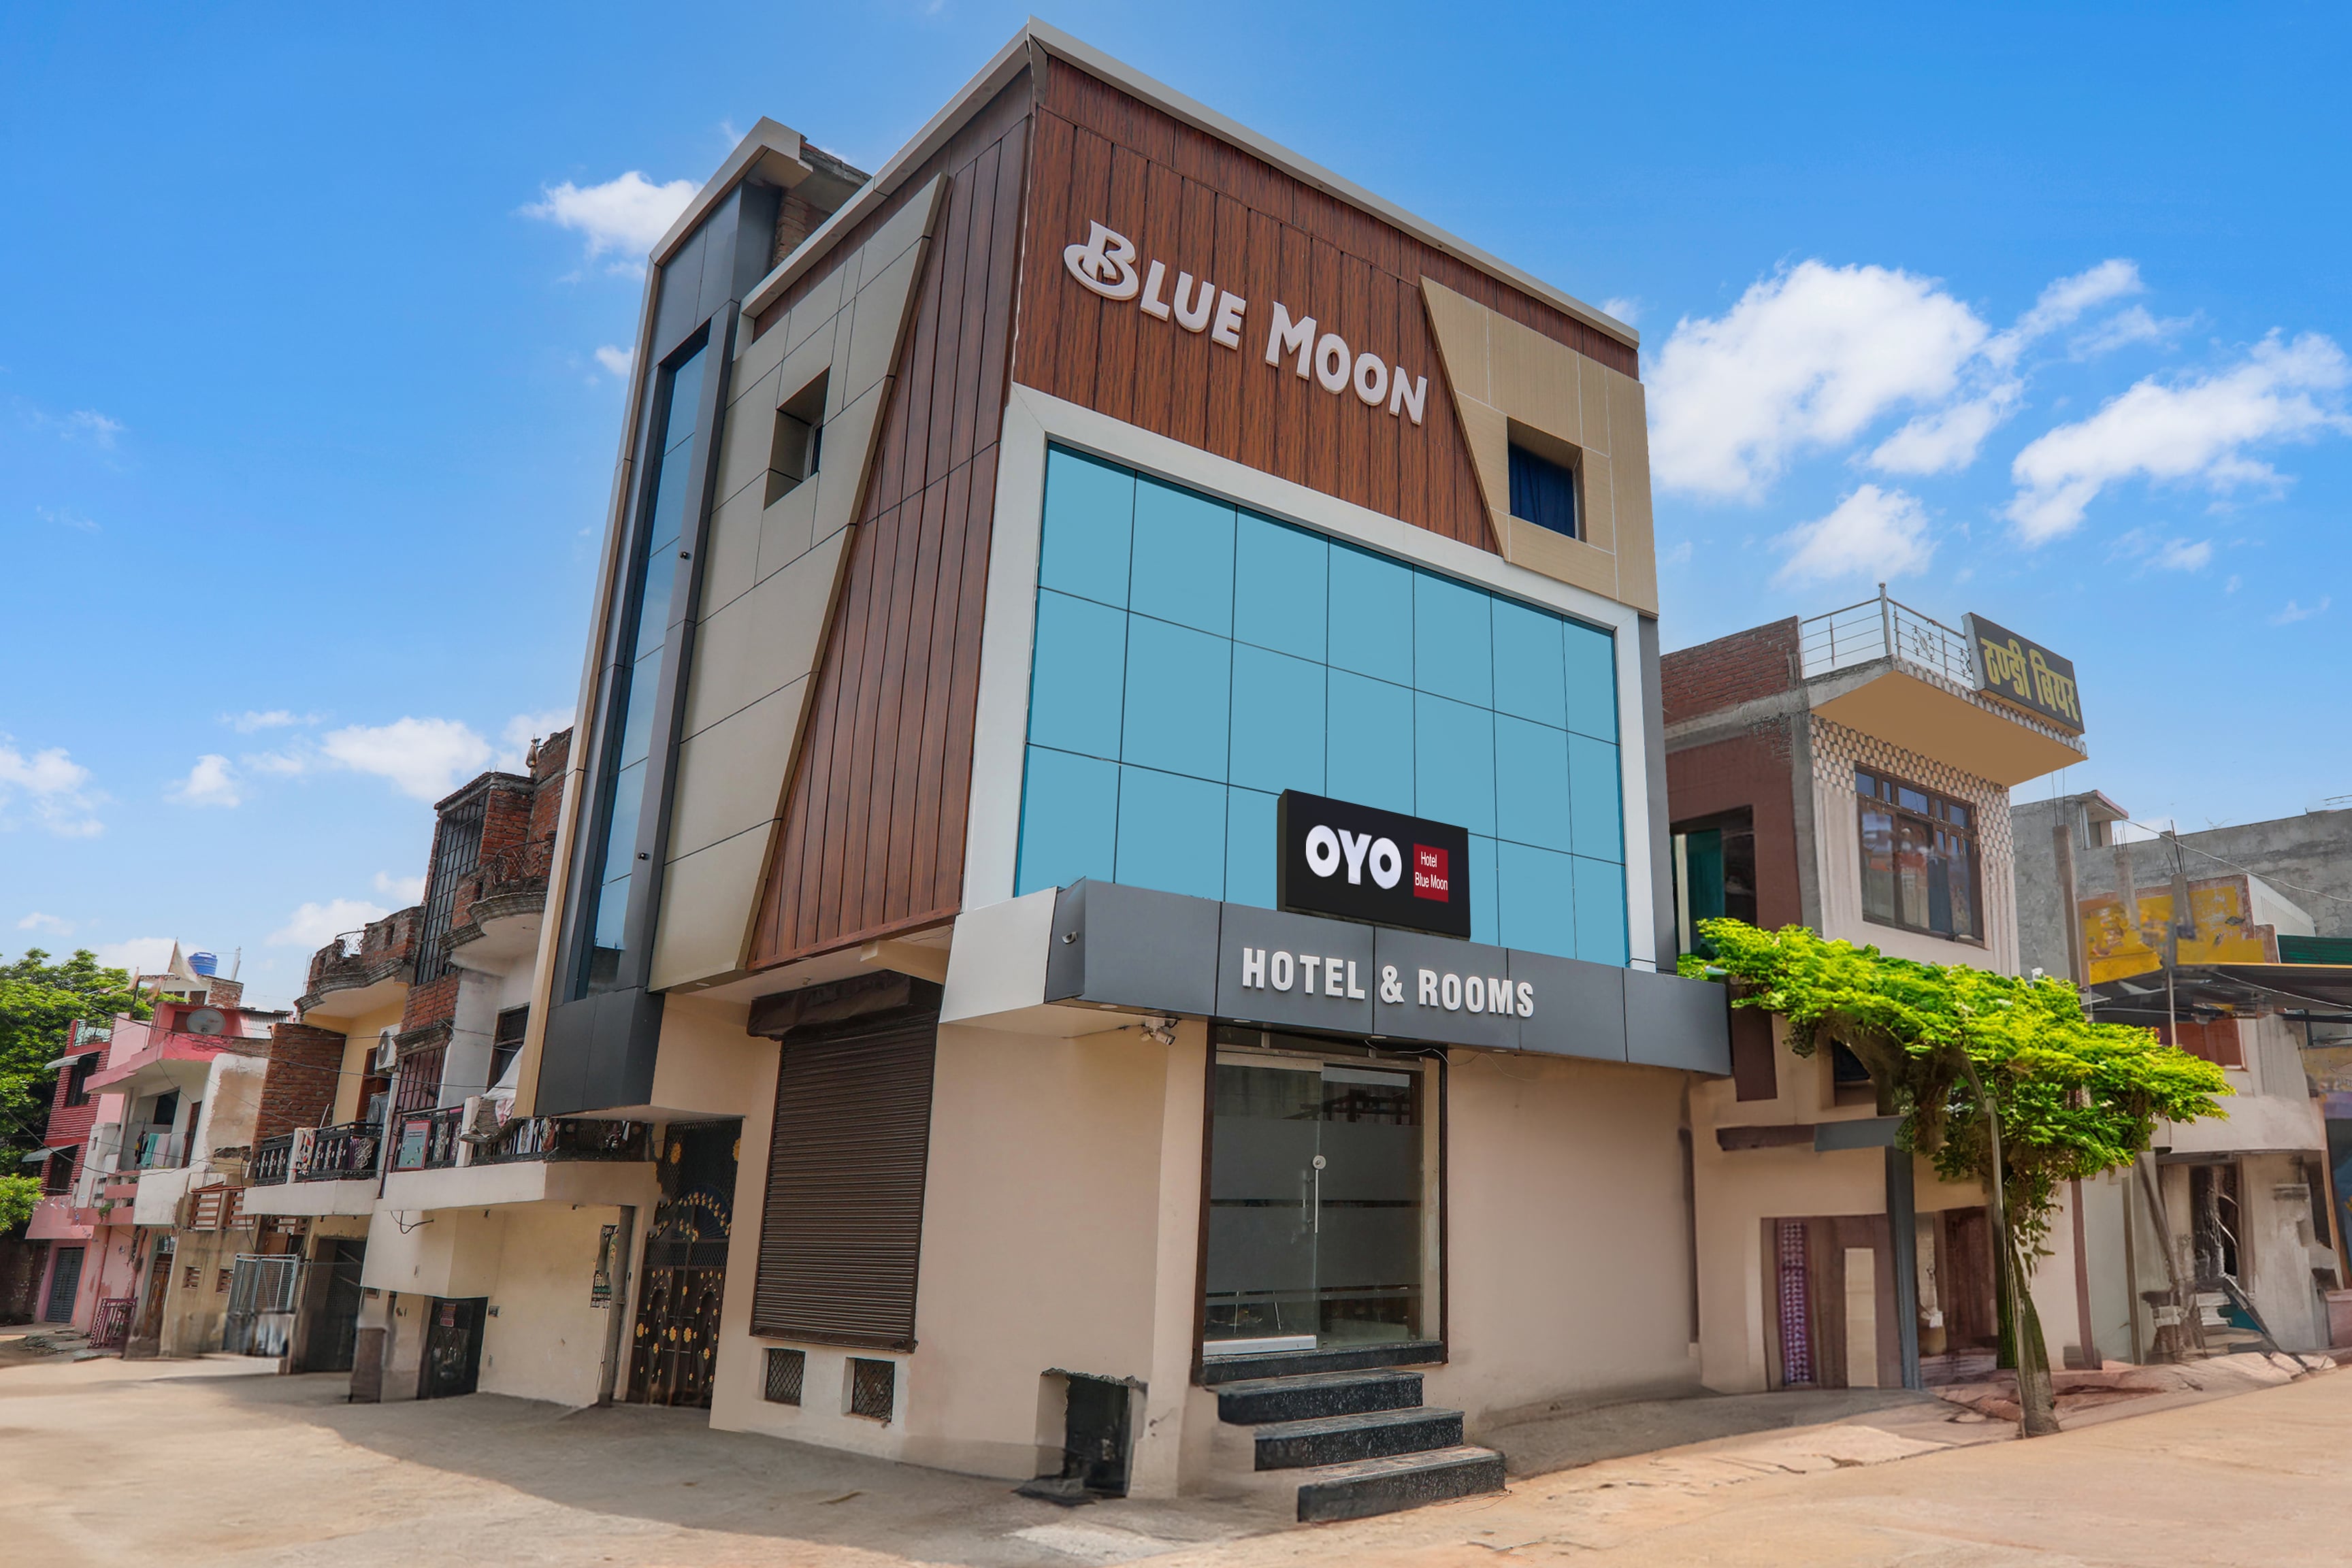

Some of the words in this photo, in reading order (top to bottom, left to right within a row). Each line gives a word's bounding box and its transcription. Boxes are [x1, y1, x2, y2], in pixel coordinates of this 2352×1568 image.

[1063, 219, 1247, 350] BLUE
[1264, 300, 1428, 427] MOON
[2029, 648, 2080, 723] बियर
[1305, 824, 1403, 890] OYO
[1415, 871, 1430, 888] Blue
[1430, 874, 1448, 892] Moon
[1420, 851, 1438, 868] Hotel
[1241, 947, 1366, 1000] HOTEL
[1379, 964, 1405, 1005] &
[1418, 968, 1535, 1018] ROOMS
